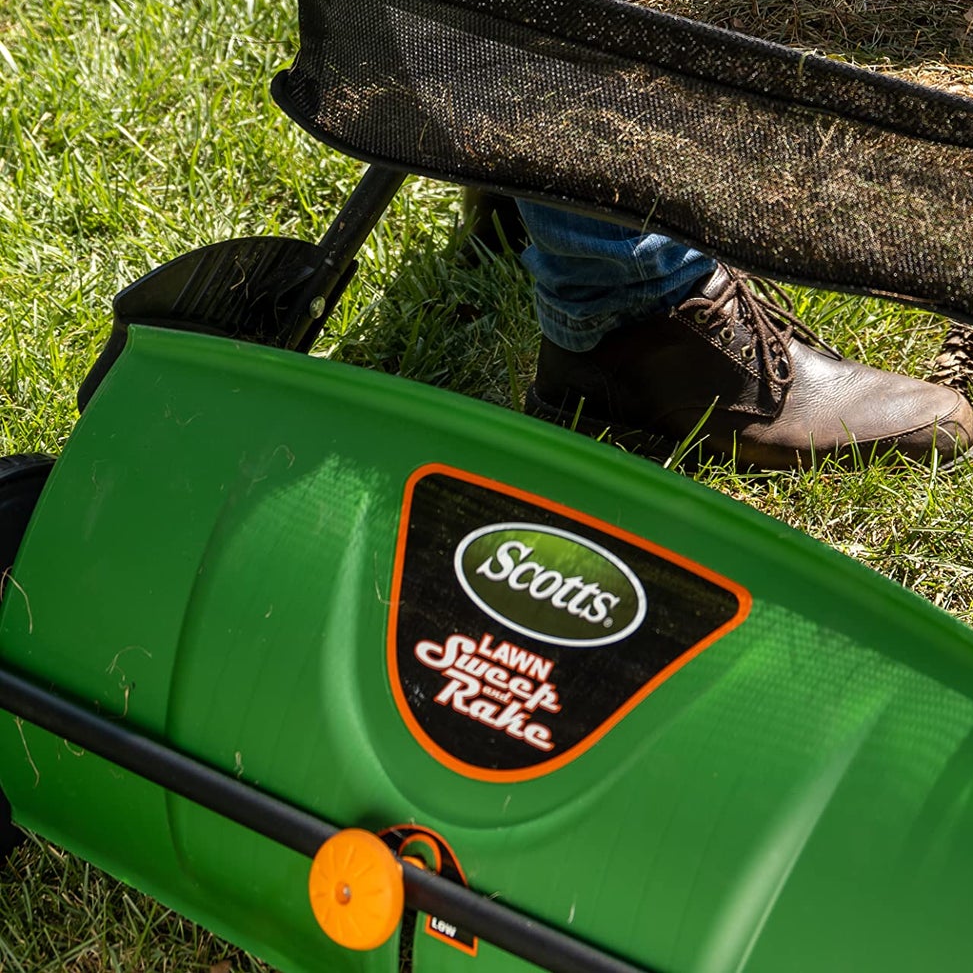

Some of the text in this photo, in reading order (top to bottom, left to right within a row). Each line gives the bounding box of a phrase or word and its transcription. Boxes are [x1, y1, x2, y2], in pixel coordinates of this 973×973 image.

[415, 634, 561, 712] Sweep
[476, 634, 554, 681] LAWN
[434, 670, 555, 751] Rake
[483, 685, 511, 705] and
[431, 917, 457, 938] LOW
